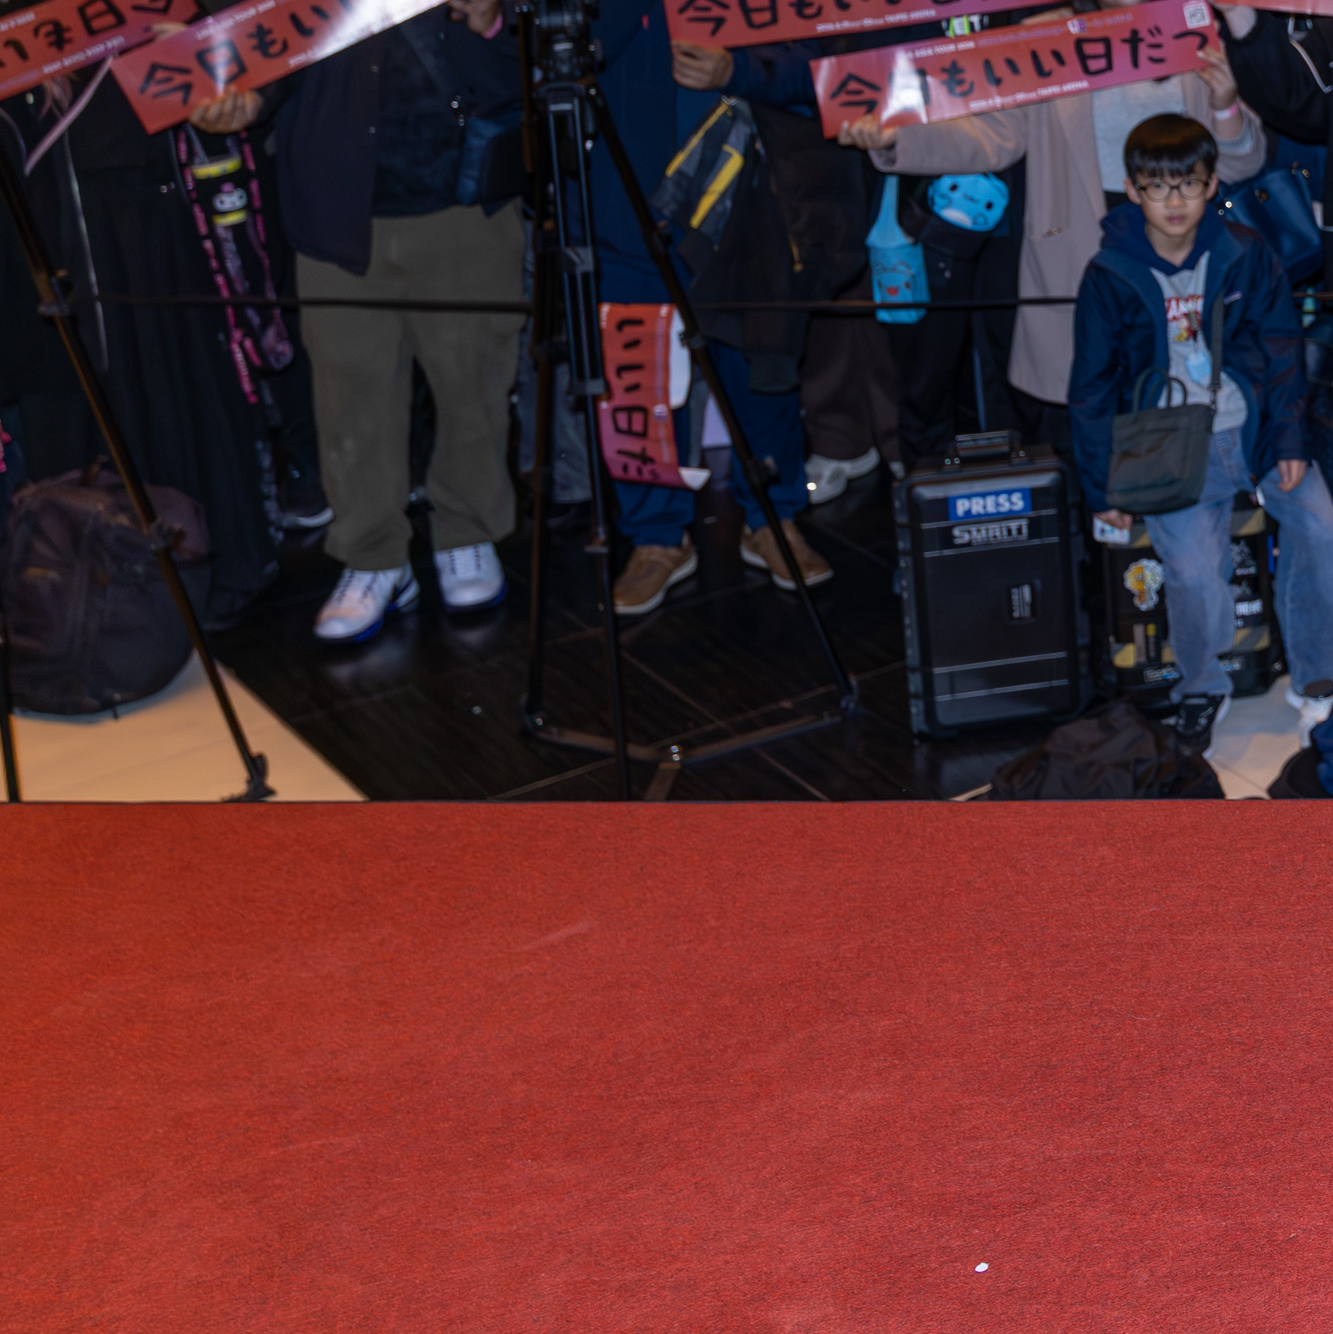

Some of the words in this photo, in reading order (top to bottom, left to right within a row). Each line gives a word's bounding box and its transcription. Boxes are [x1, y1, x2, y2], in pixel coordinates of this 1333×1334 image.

[830, 27, 1209, 116] 今もいい日だっ
[955, 491, 1025, 518] PRESS
